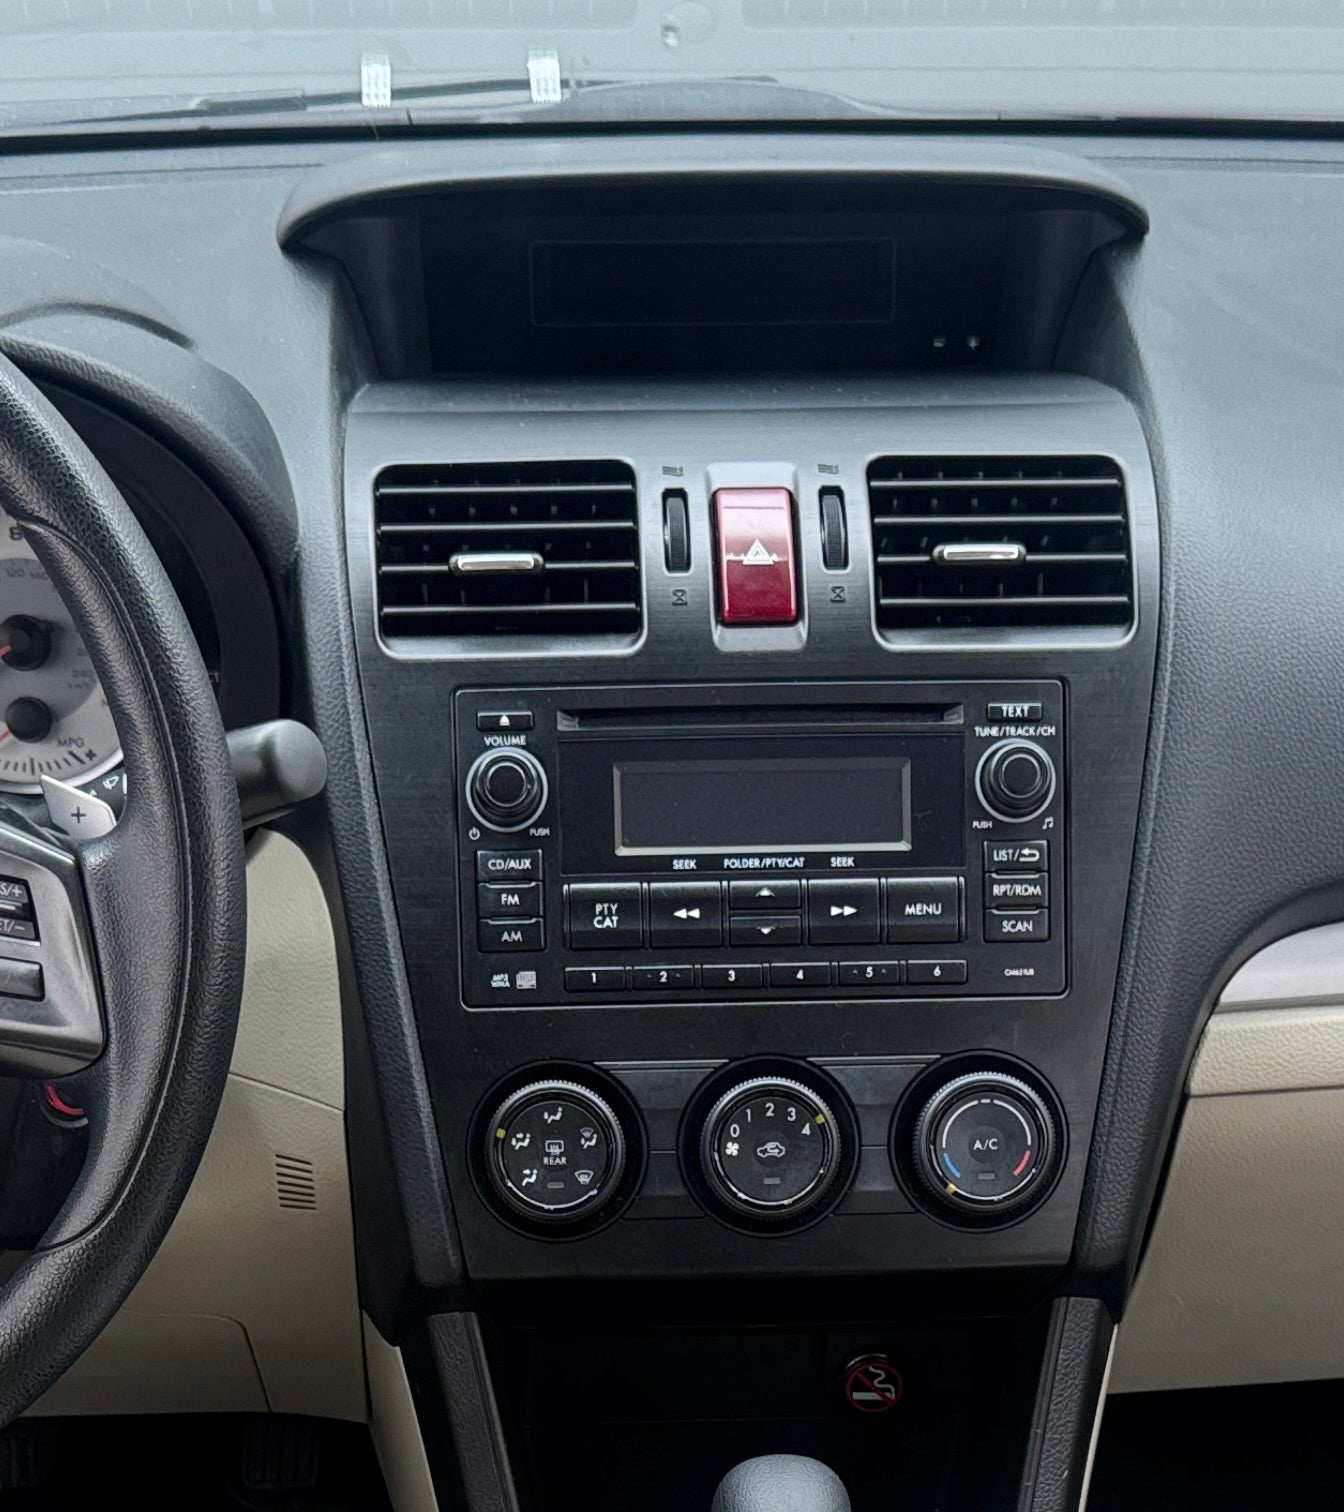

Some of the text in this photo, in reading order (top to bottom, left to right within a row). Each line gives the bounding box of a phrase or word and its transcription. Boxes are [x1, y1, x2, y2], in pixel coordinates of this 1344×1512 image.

[1001, 705, 1030, 718] TEXT
[974, 725, 1056, 737] TUNE/TRACK/CH
[57, 737, 85, 748] MPG
[483, 735, 526, 746] VOLUME
[488, 859, 532, 870] CD/AUX
[672, 859, 697, 870] SEEK
[723, 857, 805, 869] FOLDER/PTY/CAT
[830, 857, 855, 868] SEEK
[992, 884, 1042, 896] RPT/RDM
[501, 894, 520, 905] FM
[595, 903, 618, 915] PTY
[905, 903, 942, 916] MENU
[593, 917, 619, 929] CAT
[1002, 920, 1033, 932] SCAN
[501, 931, 523, 942] AM
[659, 971, 668, 982] 2
[728, 970, 736, 982] 3
[796, 969, 804, 980] 4
[865, 966, 874, 978] 5
[933, 966, 942, 977] 6
[591, 972, 597, 984] 1
[746, 1108, 752, 1123] 1
[765, 1102, 775, 1117] 2
[787, 1107, 796, 1121] 3
[730, 1123, 740, 1138] 0
[801, 1122, 811, 1136] 4
[973, 1138, 999, 1150] A/C
[543, 1156, 567, 1166] REAR
